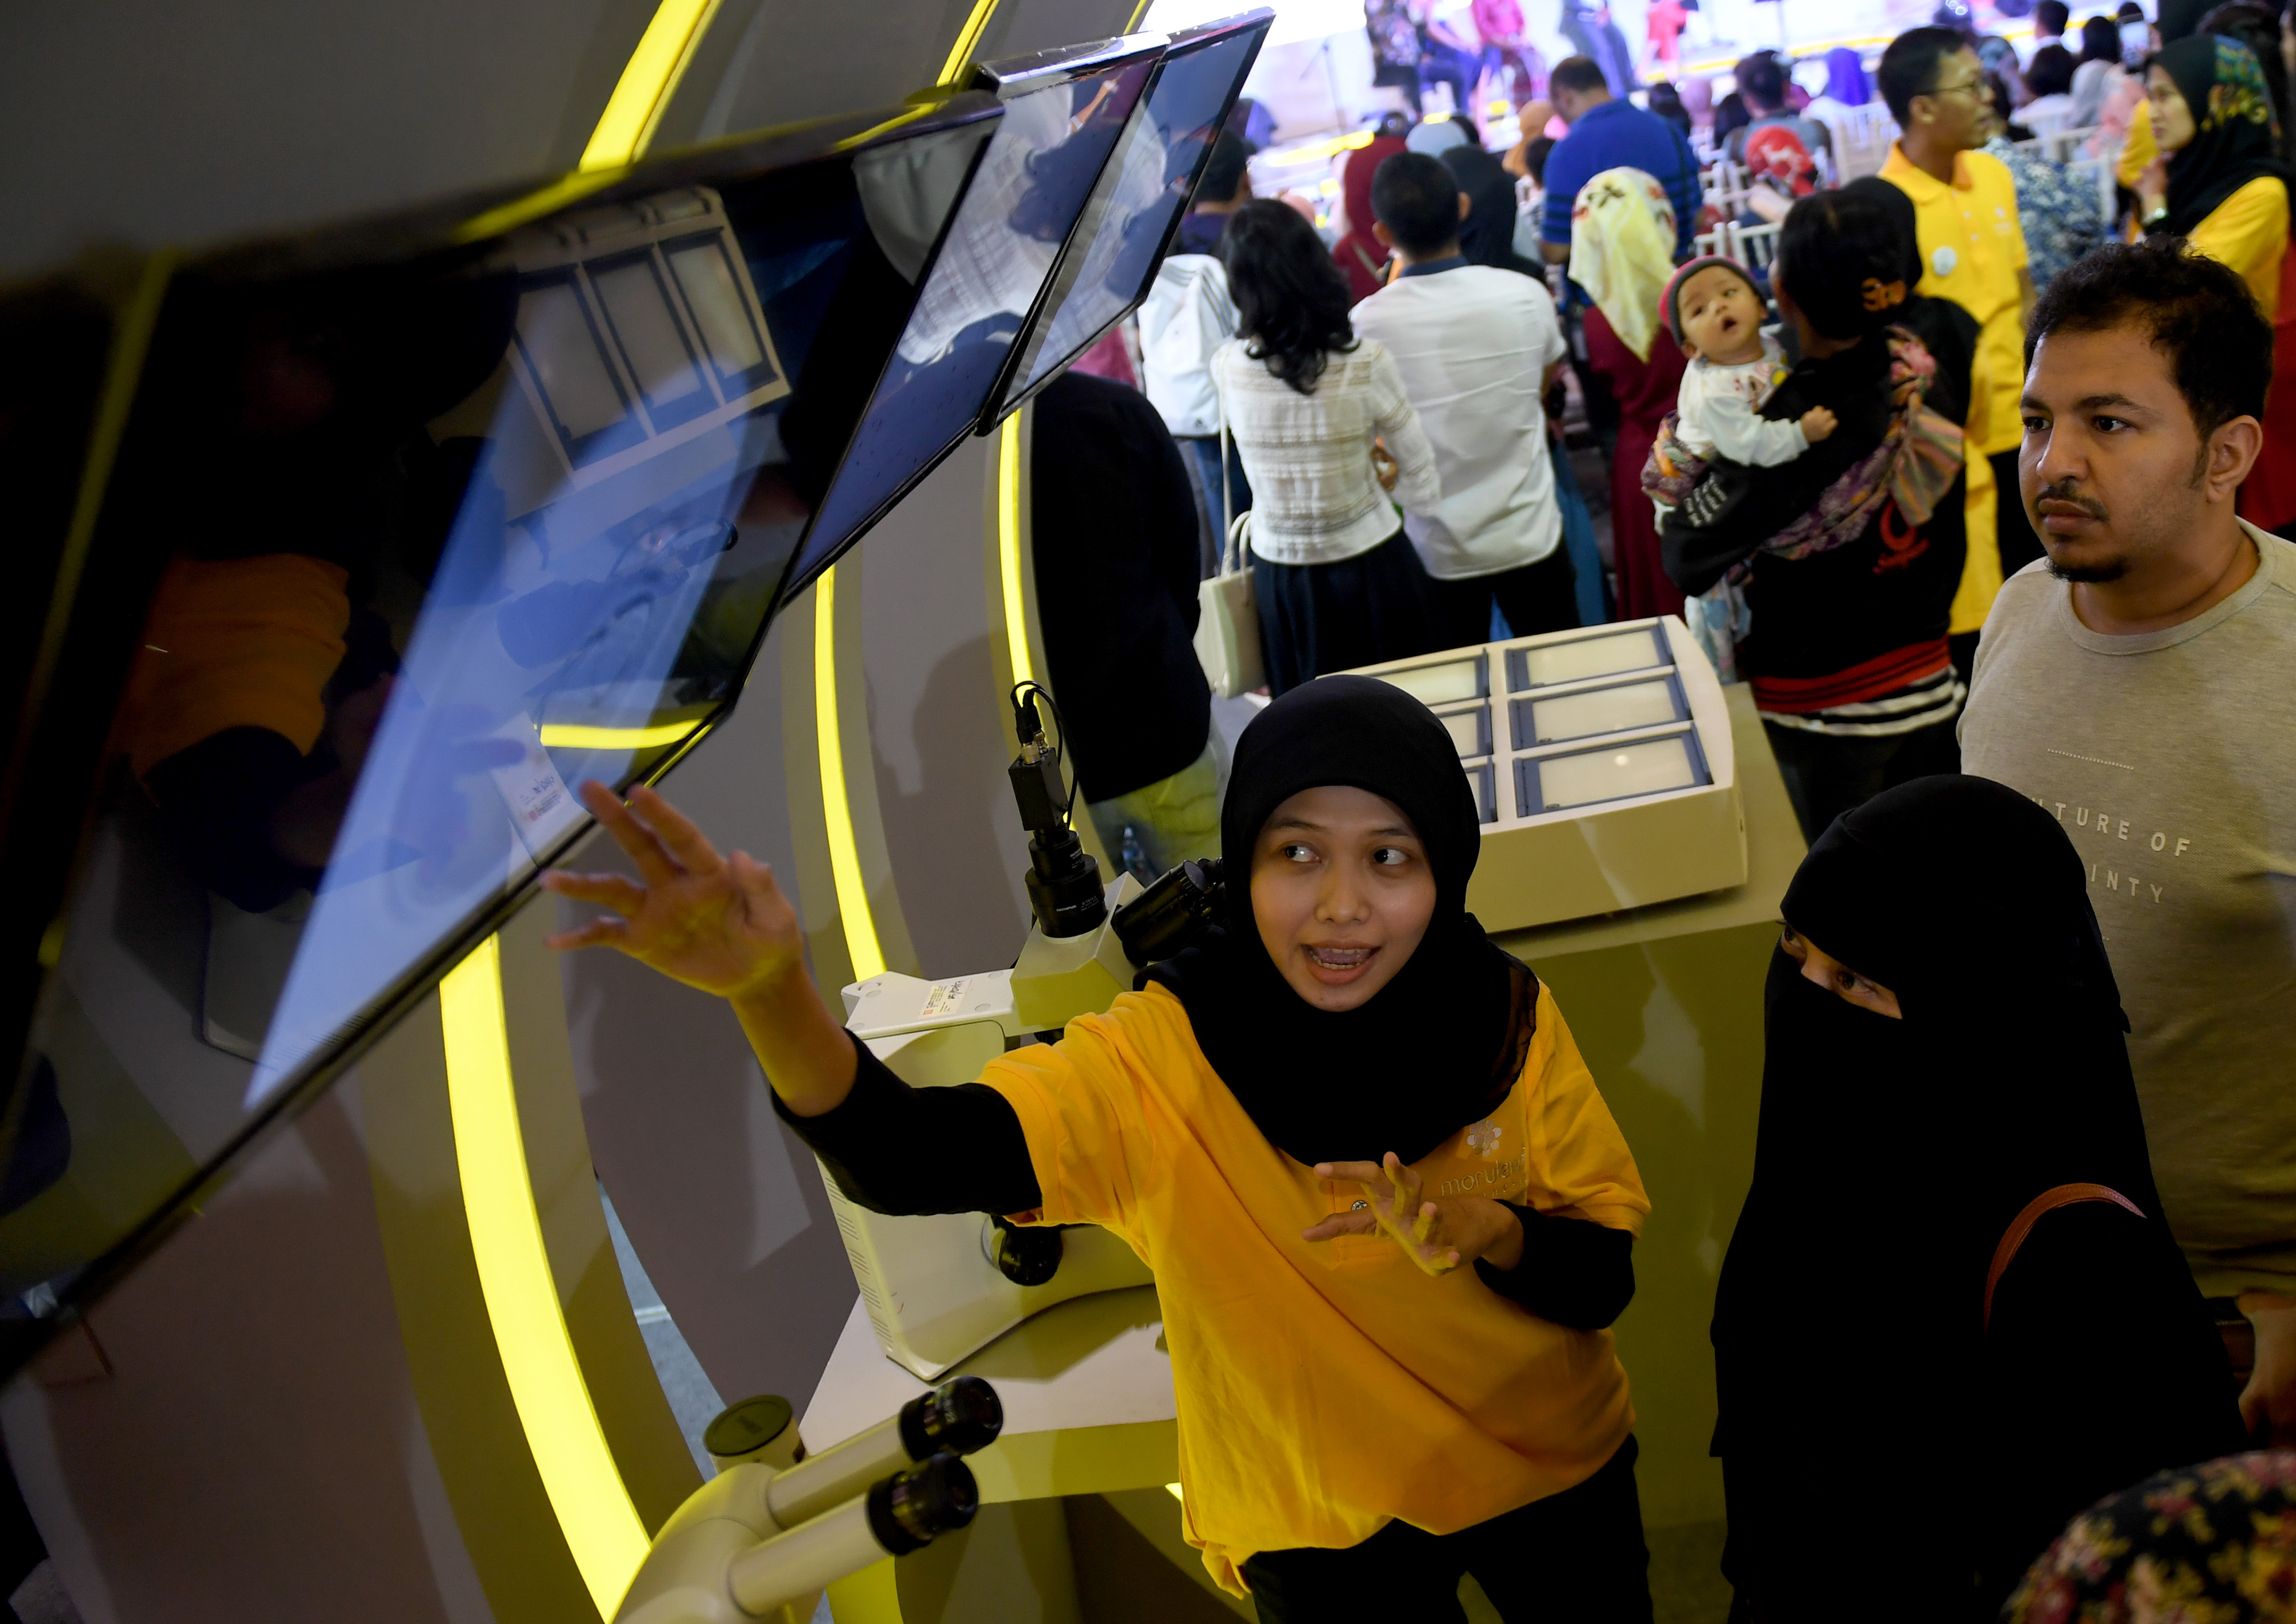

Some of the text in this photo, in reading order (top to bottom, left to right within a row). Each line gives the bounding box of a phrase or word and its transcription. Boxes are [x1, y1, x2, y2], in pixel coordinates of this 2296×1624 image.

[2032, 797, 2190, 857] TURE OF
[2091, 864, 2163, 904] INTY
